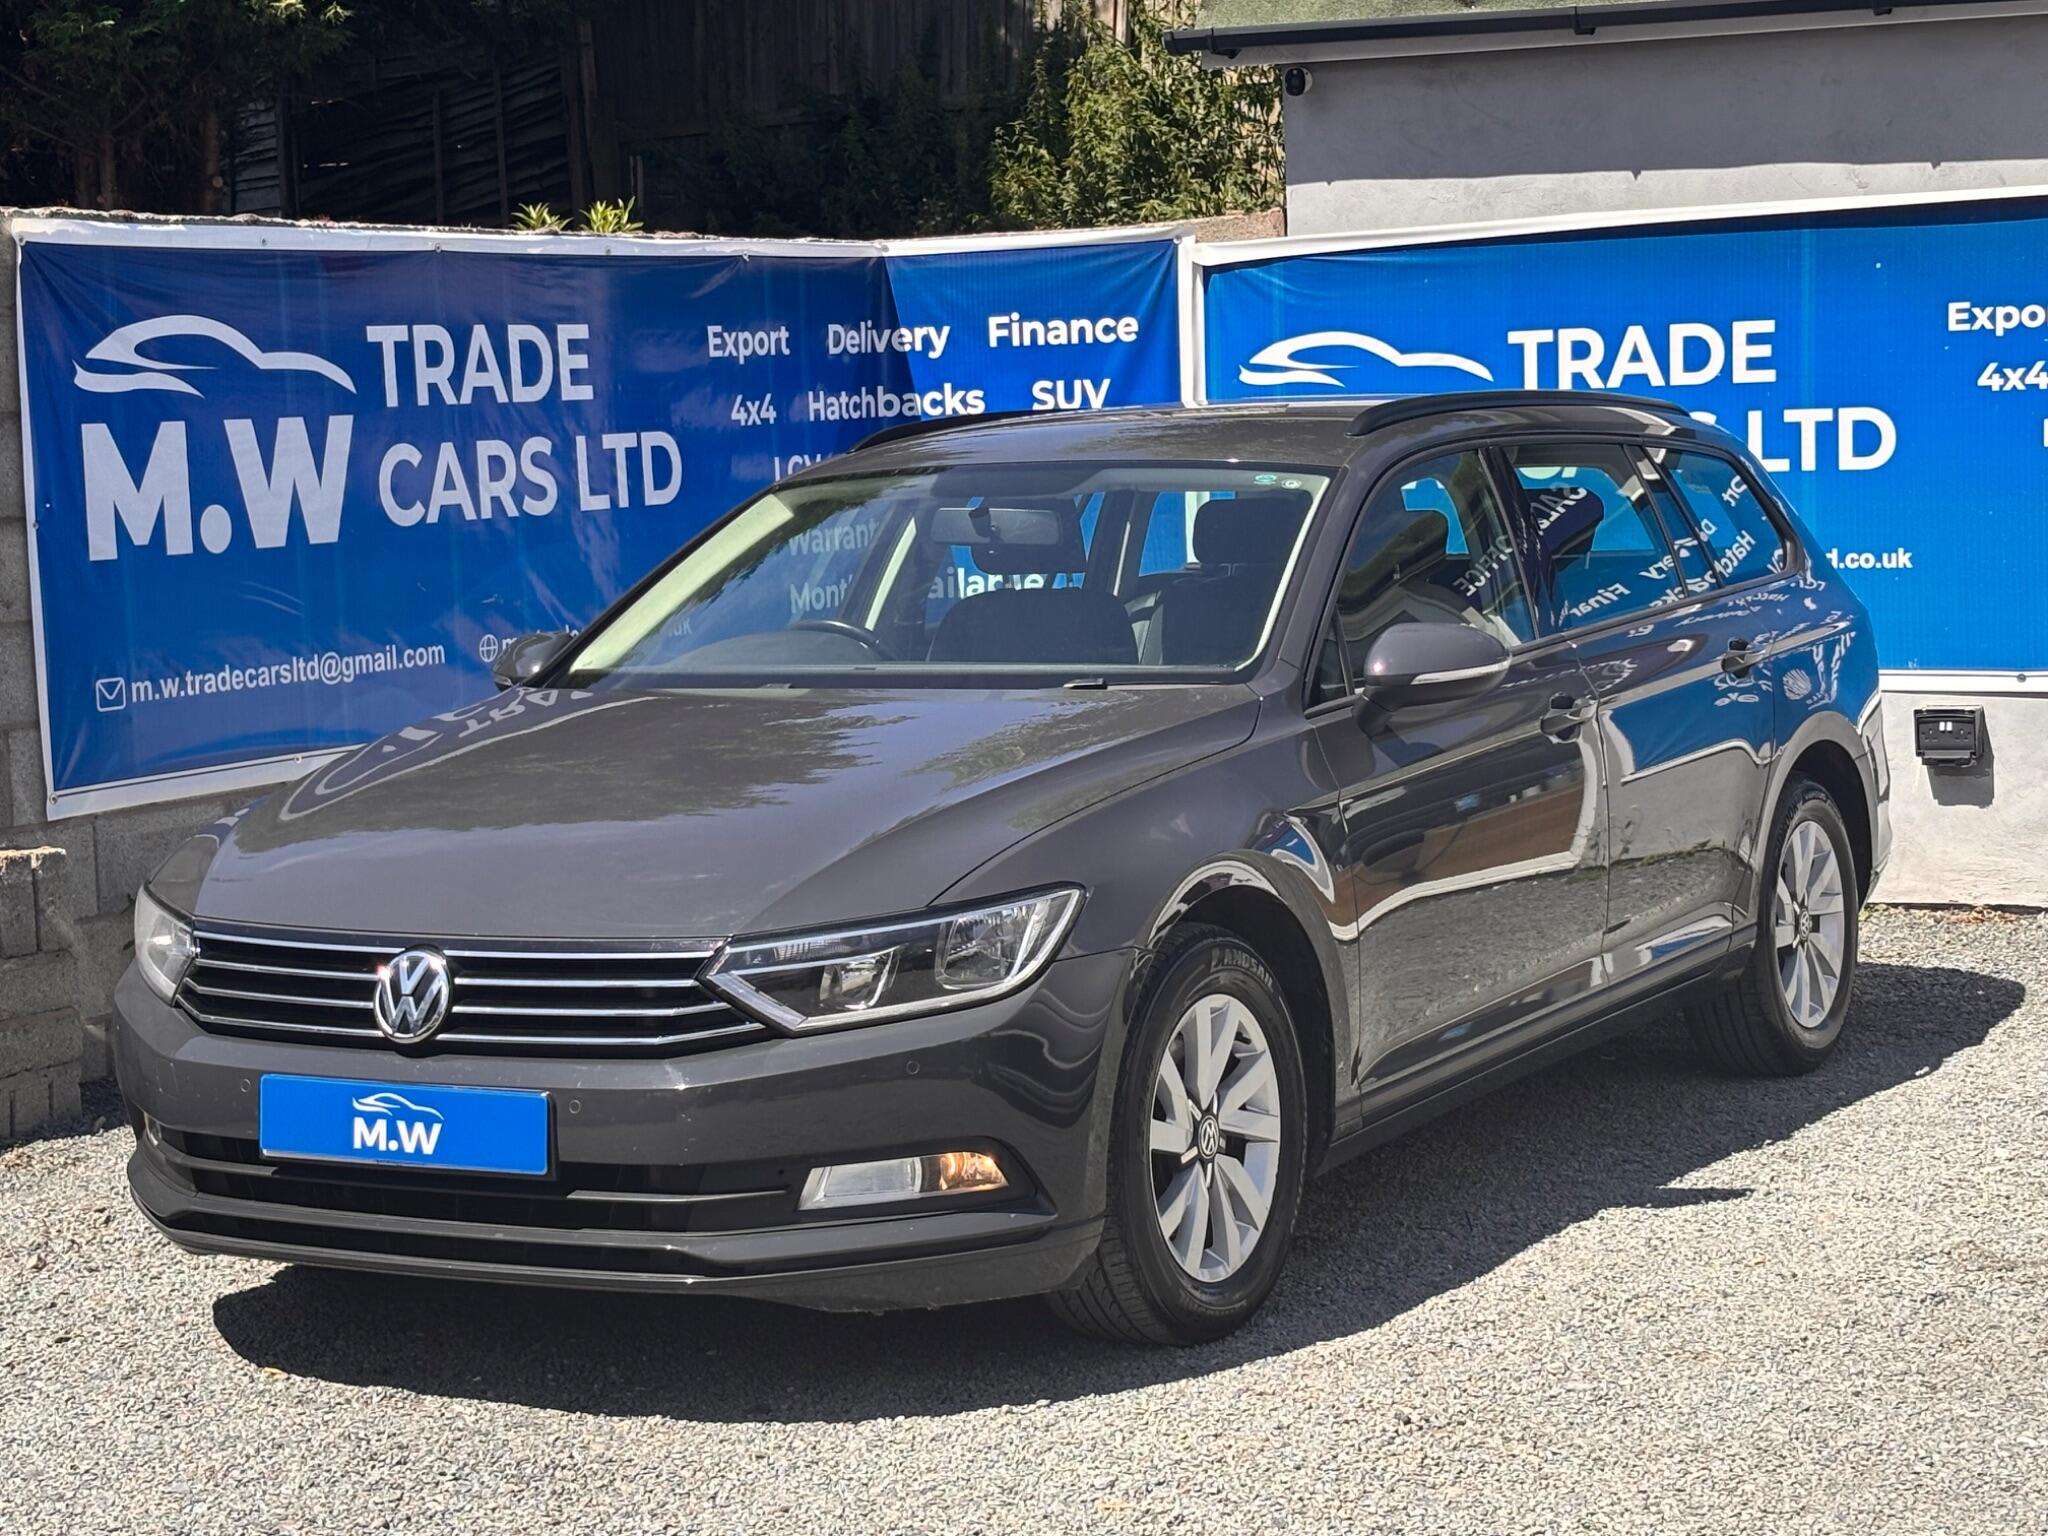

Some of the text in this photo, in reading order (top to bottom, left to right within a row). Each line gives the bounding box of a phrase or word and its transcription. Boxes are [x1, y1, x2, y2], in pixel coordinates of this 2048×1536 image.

[708, 312, 1139, 364] Export Delivery Finance
[1947, 302, 2048, 337] Expo
[365, 323, 595, 408] TRADE
[1507, 318, 1777, 391] TRADE
[1977, 360, 2048, 392] 4x4
[731, 378, 1111, 427] 4x4 Hatchbacks SUV
[1747, 406, 1897, 473] LTD
[81, 413, 355, 562] M.W
[378, 430, 683, 527] CARS LTD
[131, 644, 446, 703] m.w.tradecarsltd@gmail.com
[353, 1117, 442, 1155] M.W
